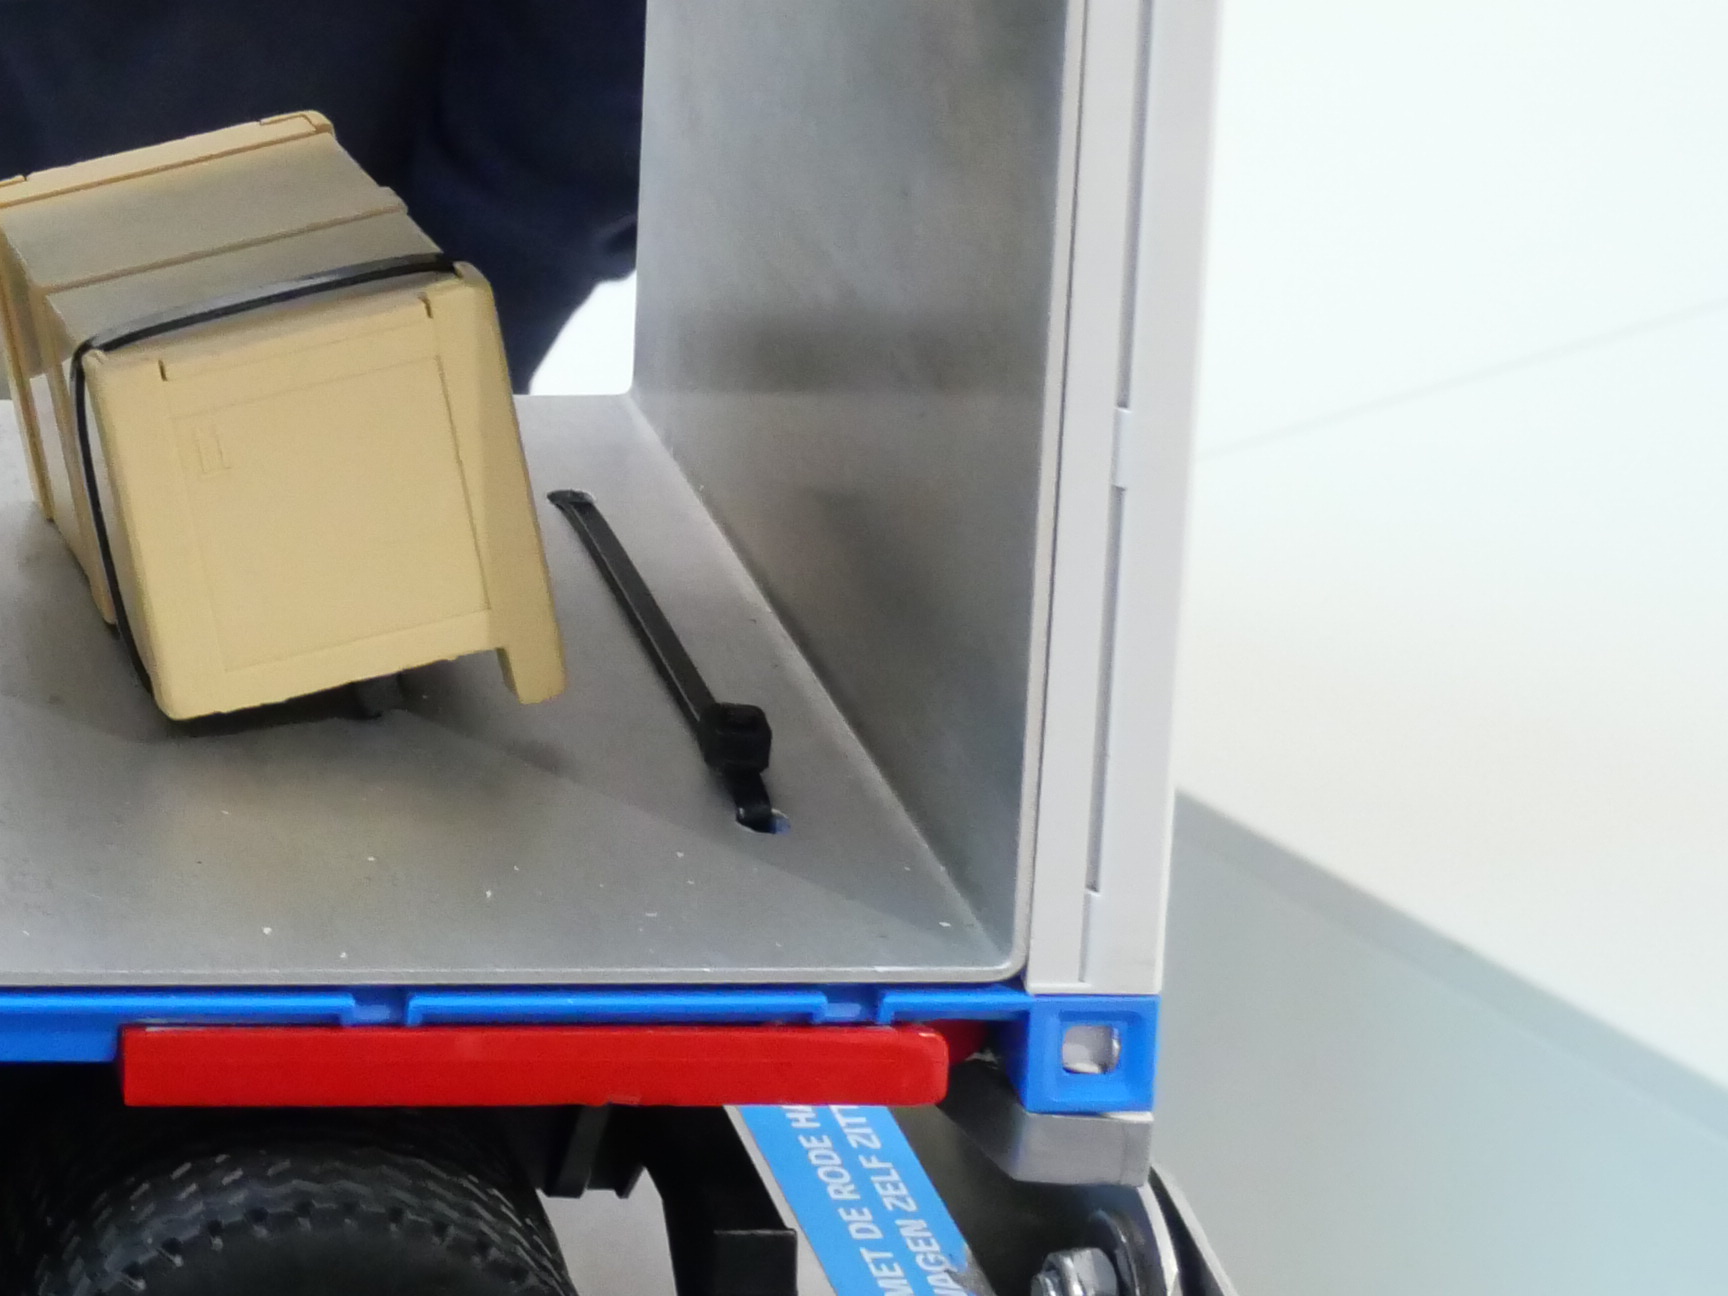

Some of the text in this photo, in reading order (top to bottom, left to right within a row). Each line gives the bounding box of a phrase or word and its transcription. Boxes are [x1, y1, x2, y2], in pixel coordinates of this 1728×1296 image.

[798, 1134, 861, 1200] RODE
[858, 1154, 918, 1212] ZELF
[838, 1207, 884, 1240] DE
